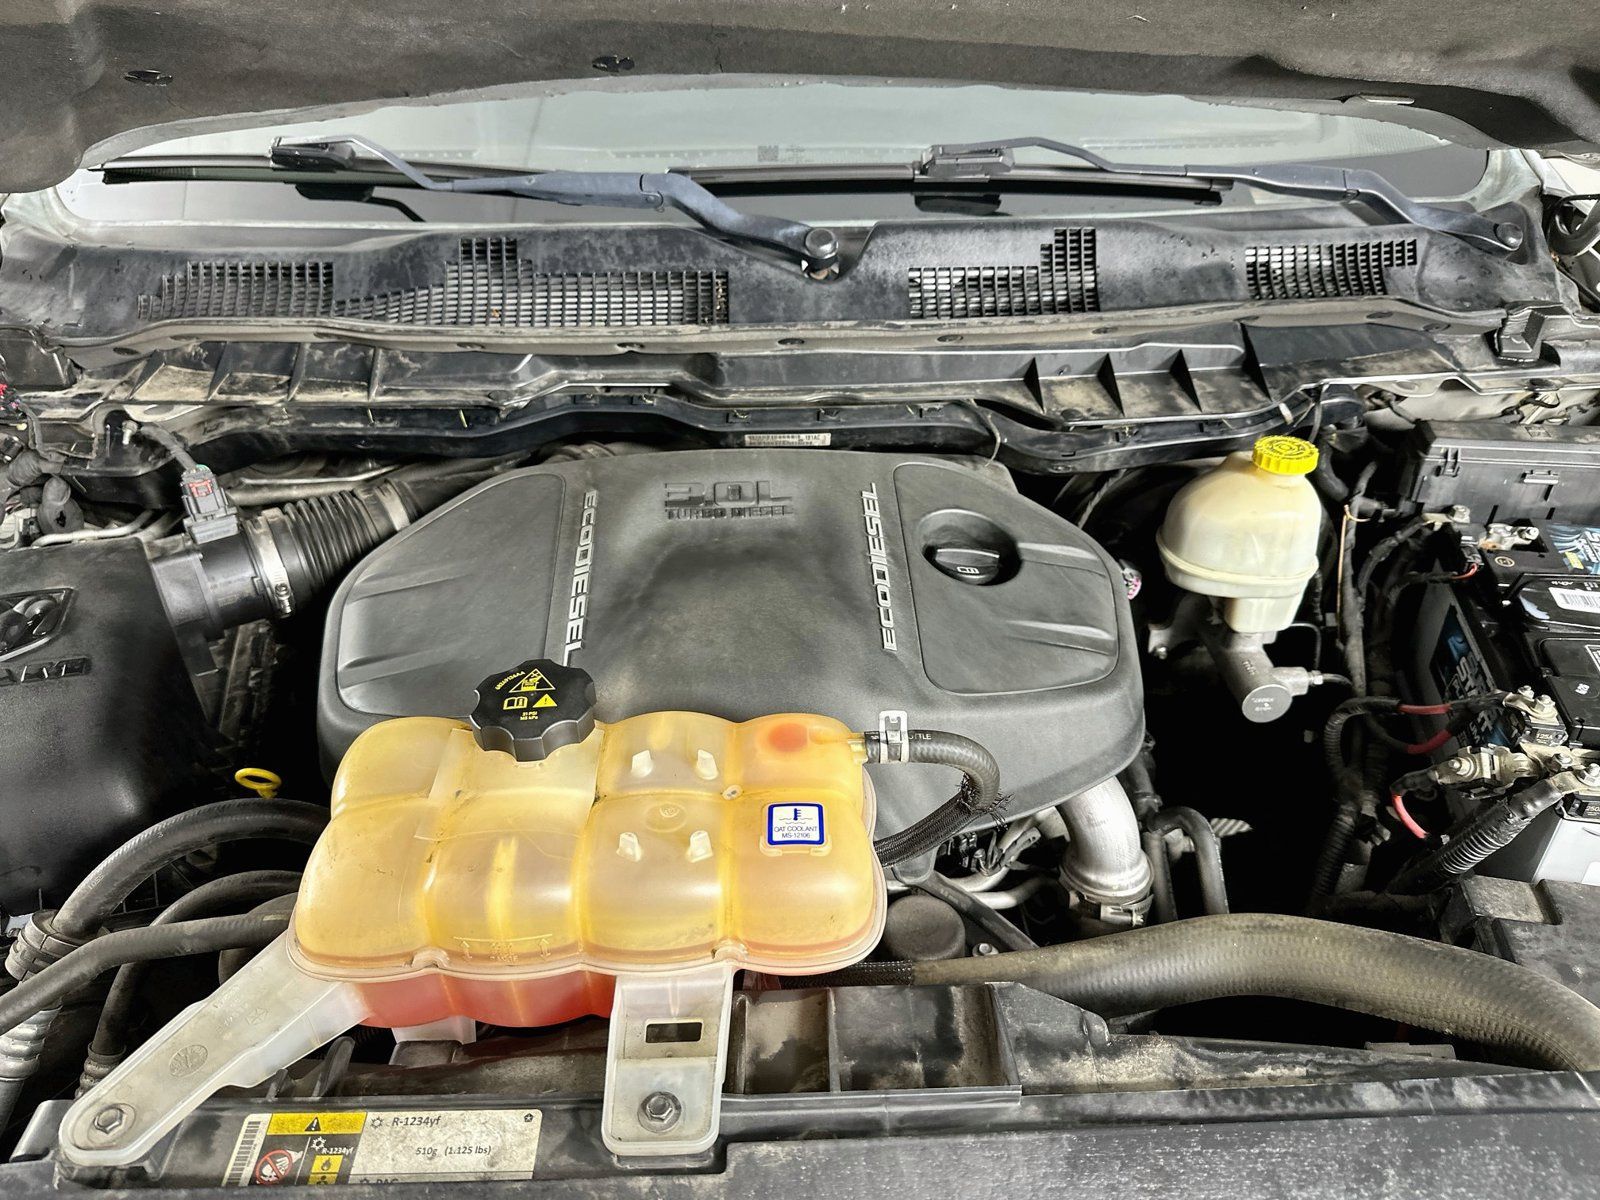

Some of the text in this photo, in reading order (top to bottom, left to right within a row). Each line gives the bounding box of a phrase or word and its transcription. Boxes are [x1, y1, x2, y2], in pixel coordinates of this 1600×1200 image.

[664, 505, 793, 519] TURBO DIESEL
[861, 482, 898, 651] ECODIESEL
[563, 489, 598, 667] ECODIESEL
[392, 1116, 441, 1127] R-1234yf
[415, 1145, 492, 1157] 510g (1.125 lbs)
